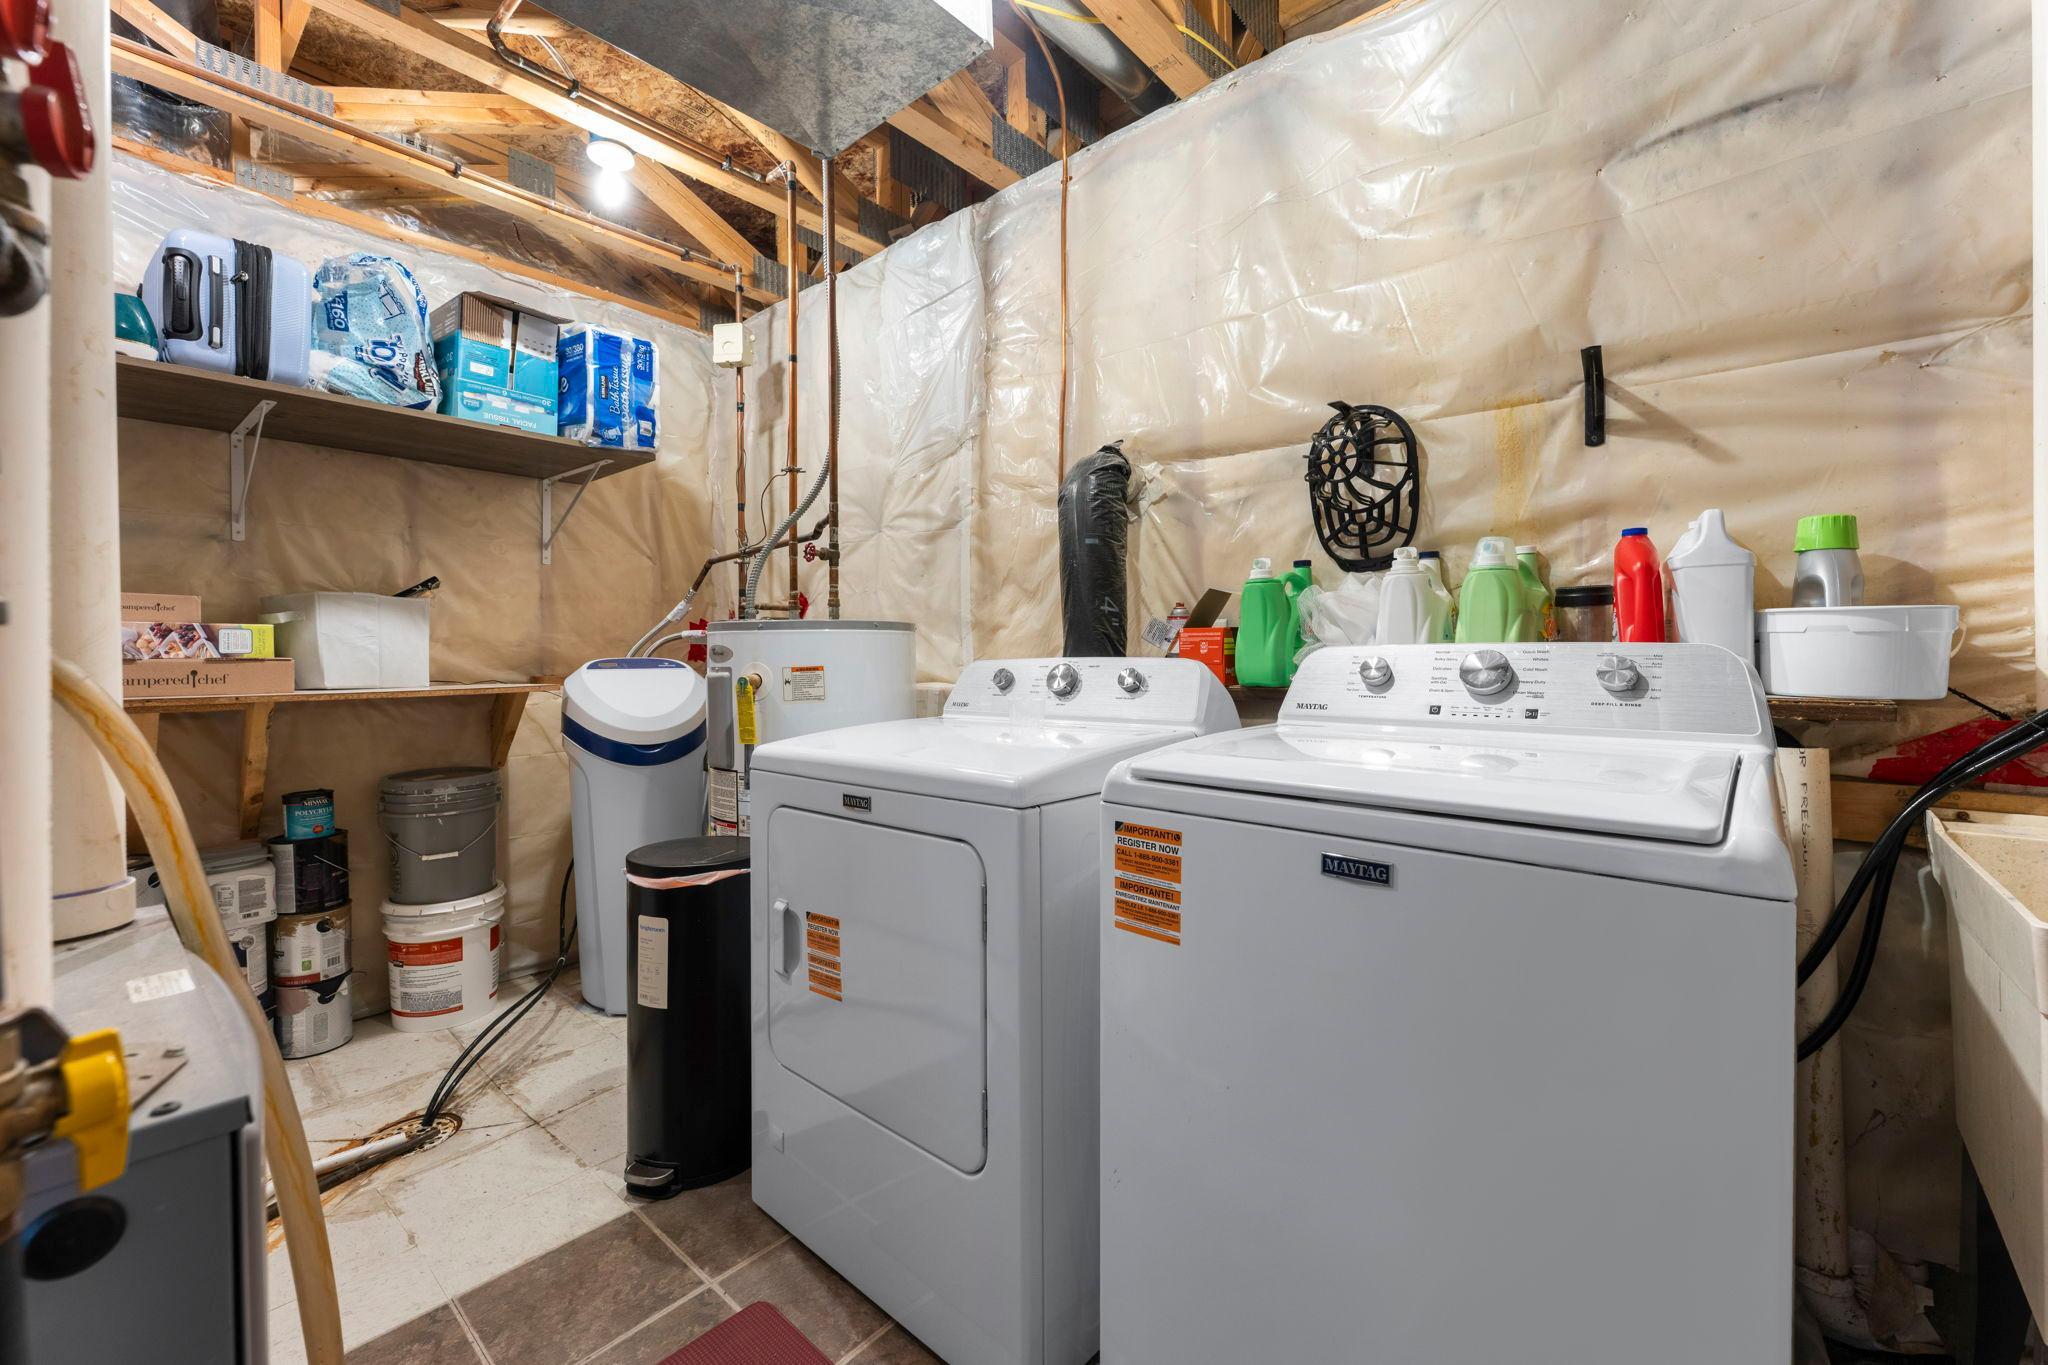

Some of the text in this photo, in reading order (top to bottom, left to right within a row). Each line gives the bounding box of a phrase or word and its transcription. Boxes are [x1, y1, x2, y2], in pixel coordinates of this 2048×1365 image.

[609, 365, 621, 415] Bath Tissue
[541, 399, 552, 407] 30
[482, 412, 537, 429] FACIAL TISSUE
[159, 604, 175, 612] chef
[122, 673, 230, 688] ampered chef
[1296, 702, 1328, 710] MAYTAG
[303, 799, 329, 807] MINWAX
[844, 796, 868, 808] MAYTAG
[1123, 825, 1174, 841] IMPORTANT!
[1116, 848, 1132, 857] CALL
[1117, 836, 1180, 855] REGISTER NOW
[1324, 858, 1387, 880] MAYTAG
[1120, 880, 1174, 901] IMPORTANTE!
[1115, 890, 1180, 911] ENREGISTREZ MAINTENANT
[807, 923, 839, 937] REGISTER NOW
